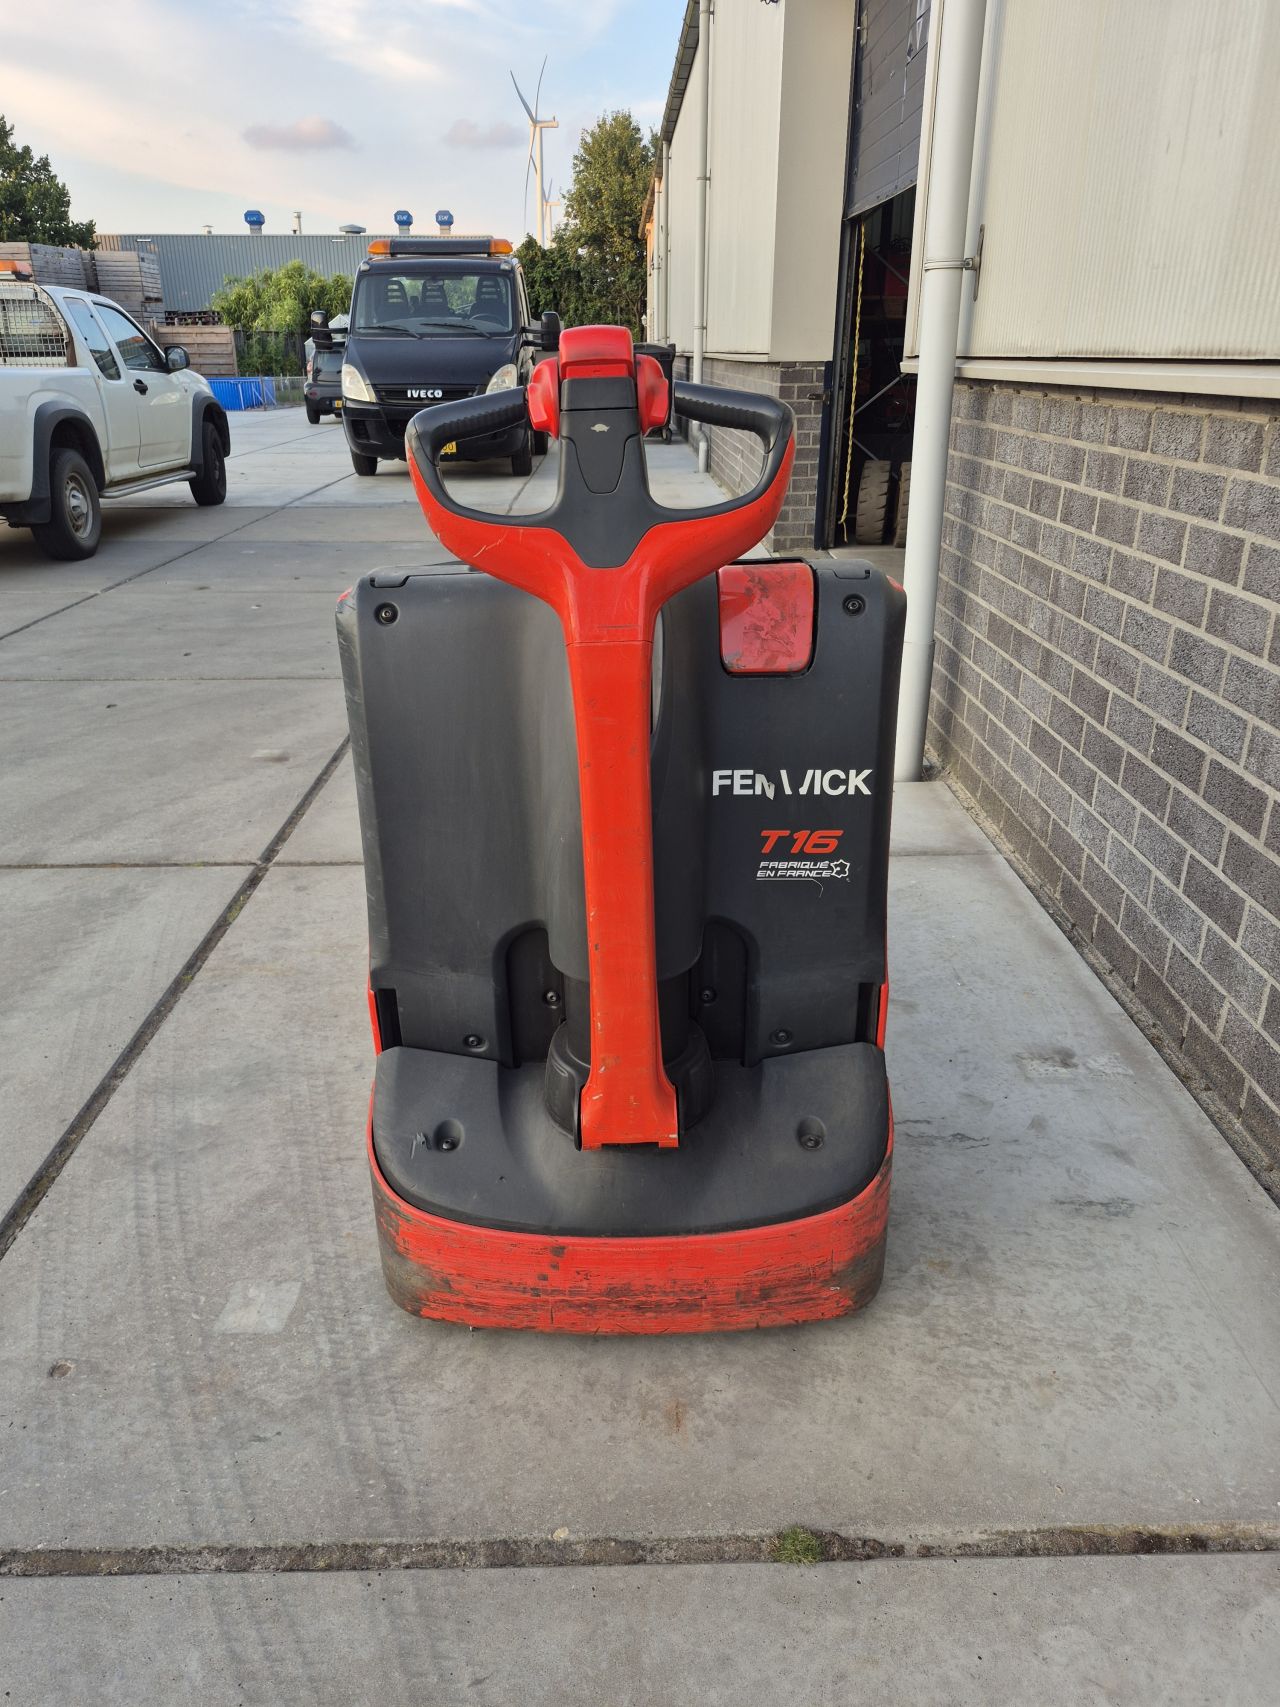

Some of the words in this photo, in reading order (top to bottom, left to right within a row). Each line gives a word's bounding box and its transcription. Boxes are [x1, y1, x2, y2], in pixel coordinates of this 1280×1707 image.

[407, 389, 443, 399] IVECO
[761, 830, 843, 854] T16
[756, 870, 776, 878] EN
[776, 870, 832, 878] FRANCE
